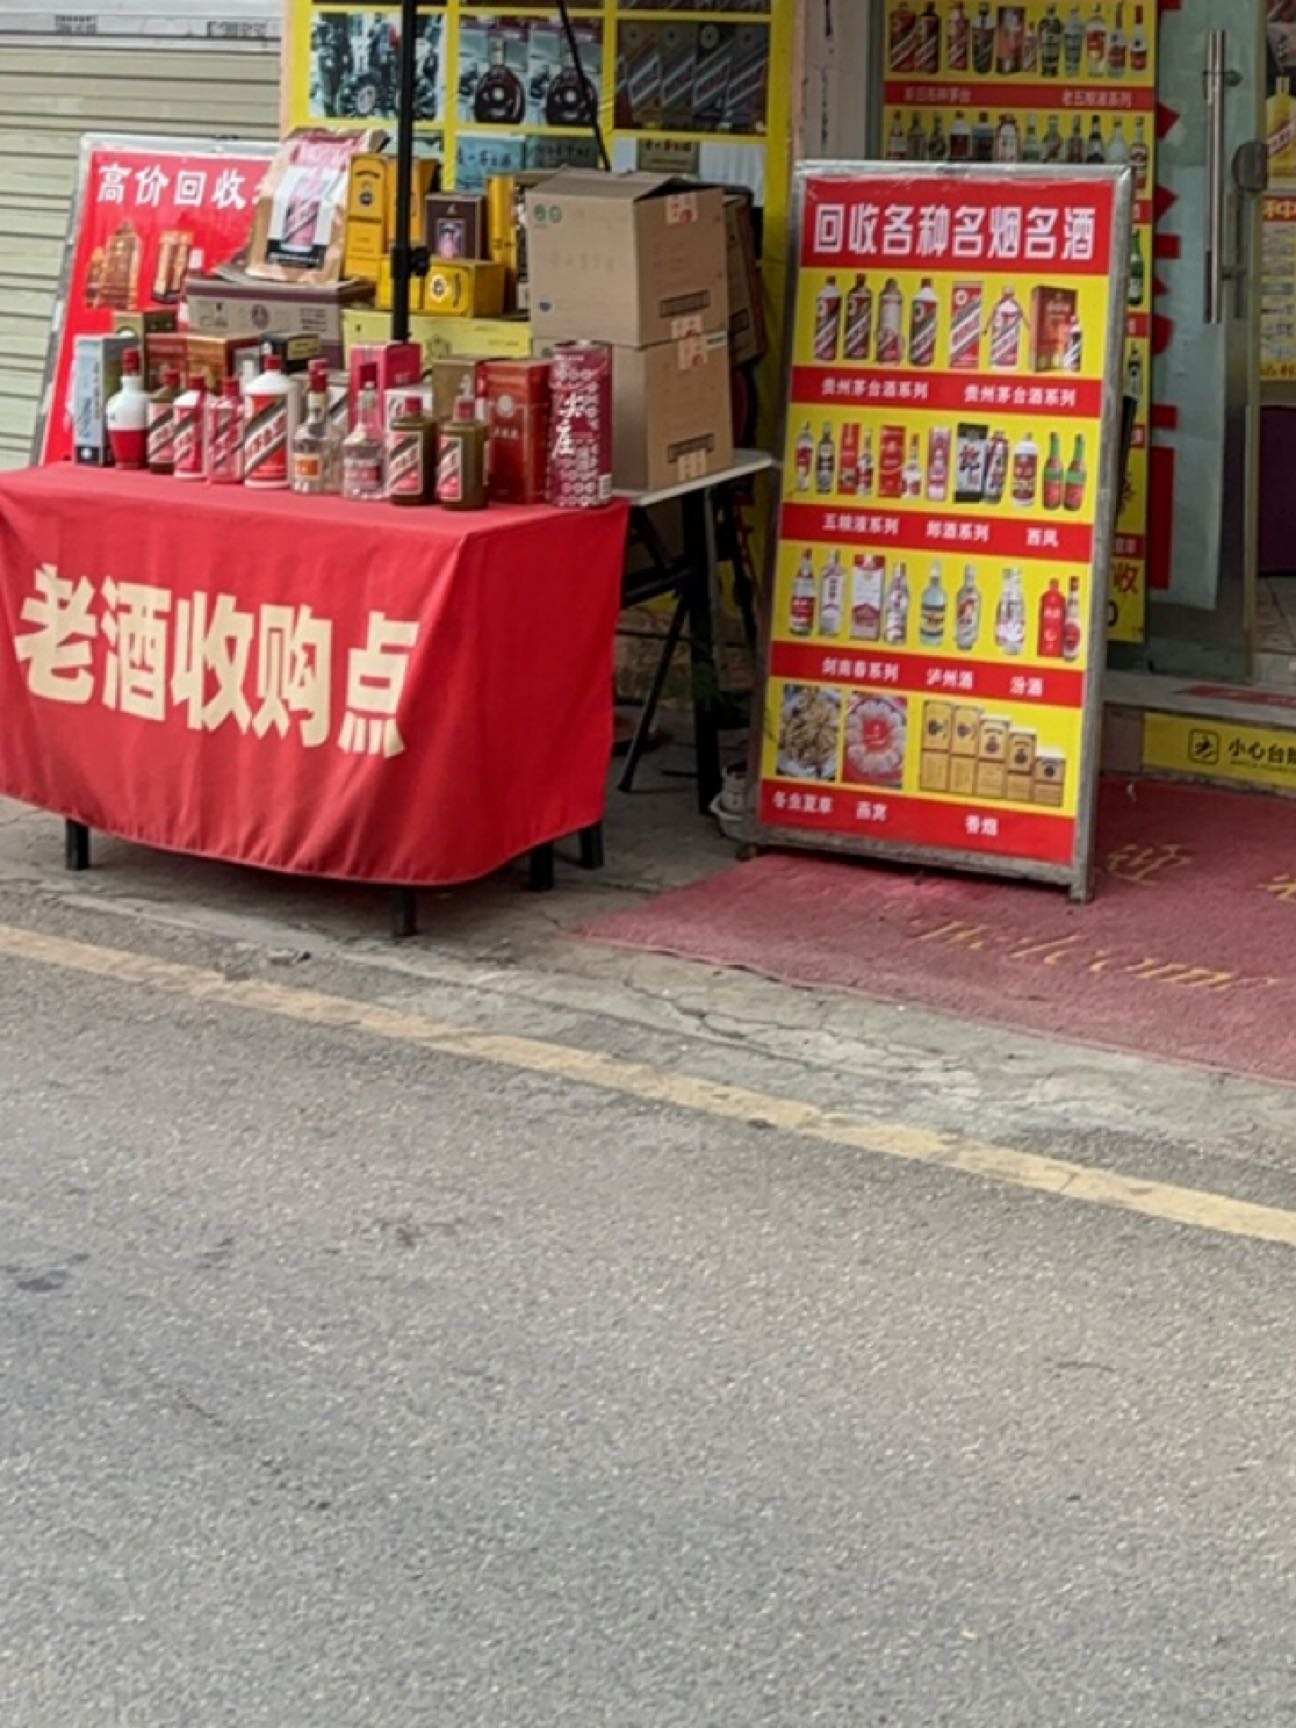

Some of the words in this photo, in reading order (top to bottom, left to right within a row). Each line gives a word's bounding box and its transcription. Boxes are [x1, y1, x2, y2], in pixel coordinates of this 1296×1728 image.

[97, 161, 269, 211] 高价回收
[812, 201, 1097, 262] 回收各种名烟名酒
[963, 384, 1076, 408] 贵州茅台酒系列
[13, 562, 421, 760] 老酒收购点
